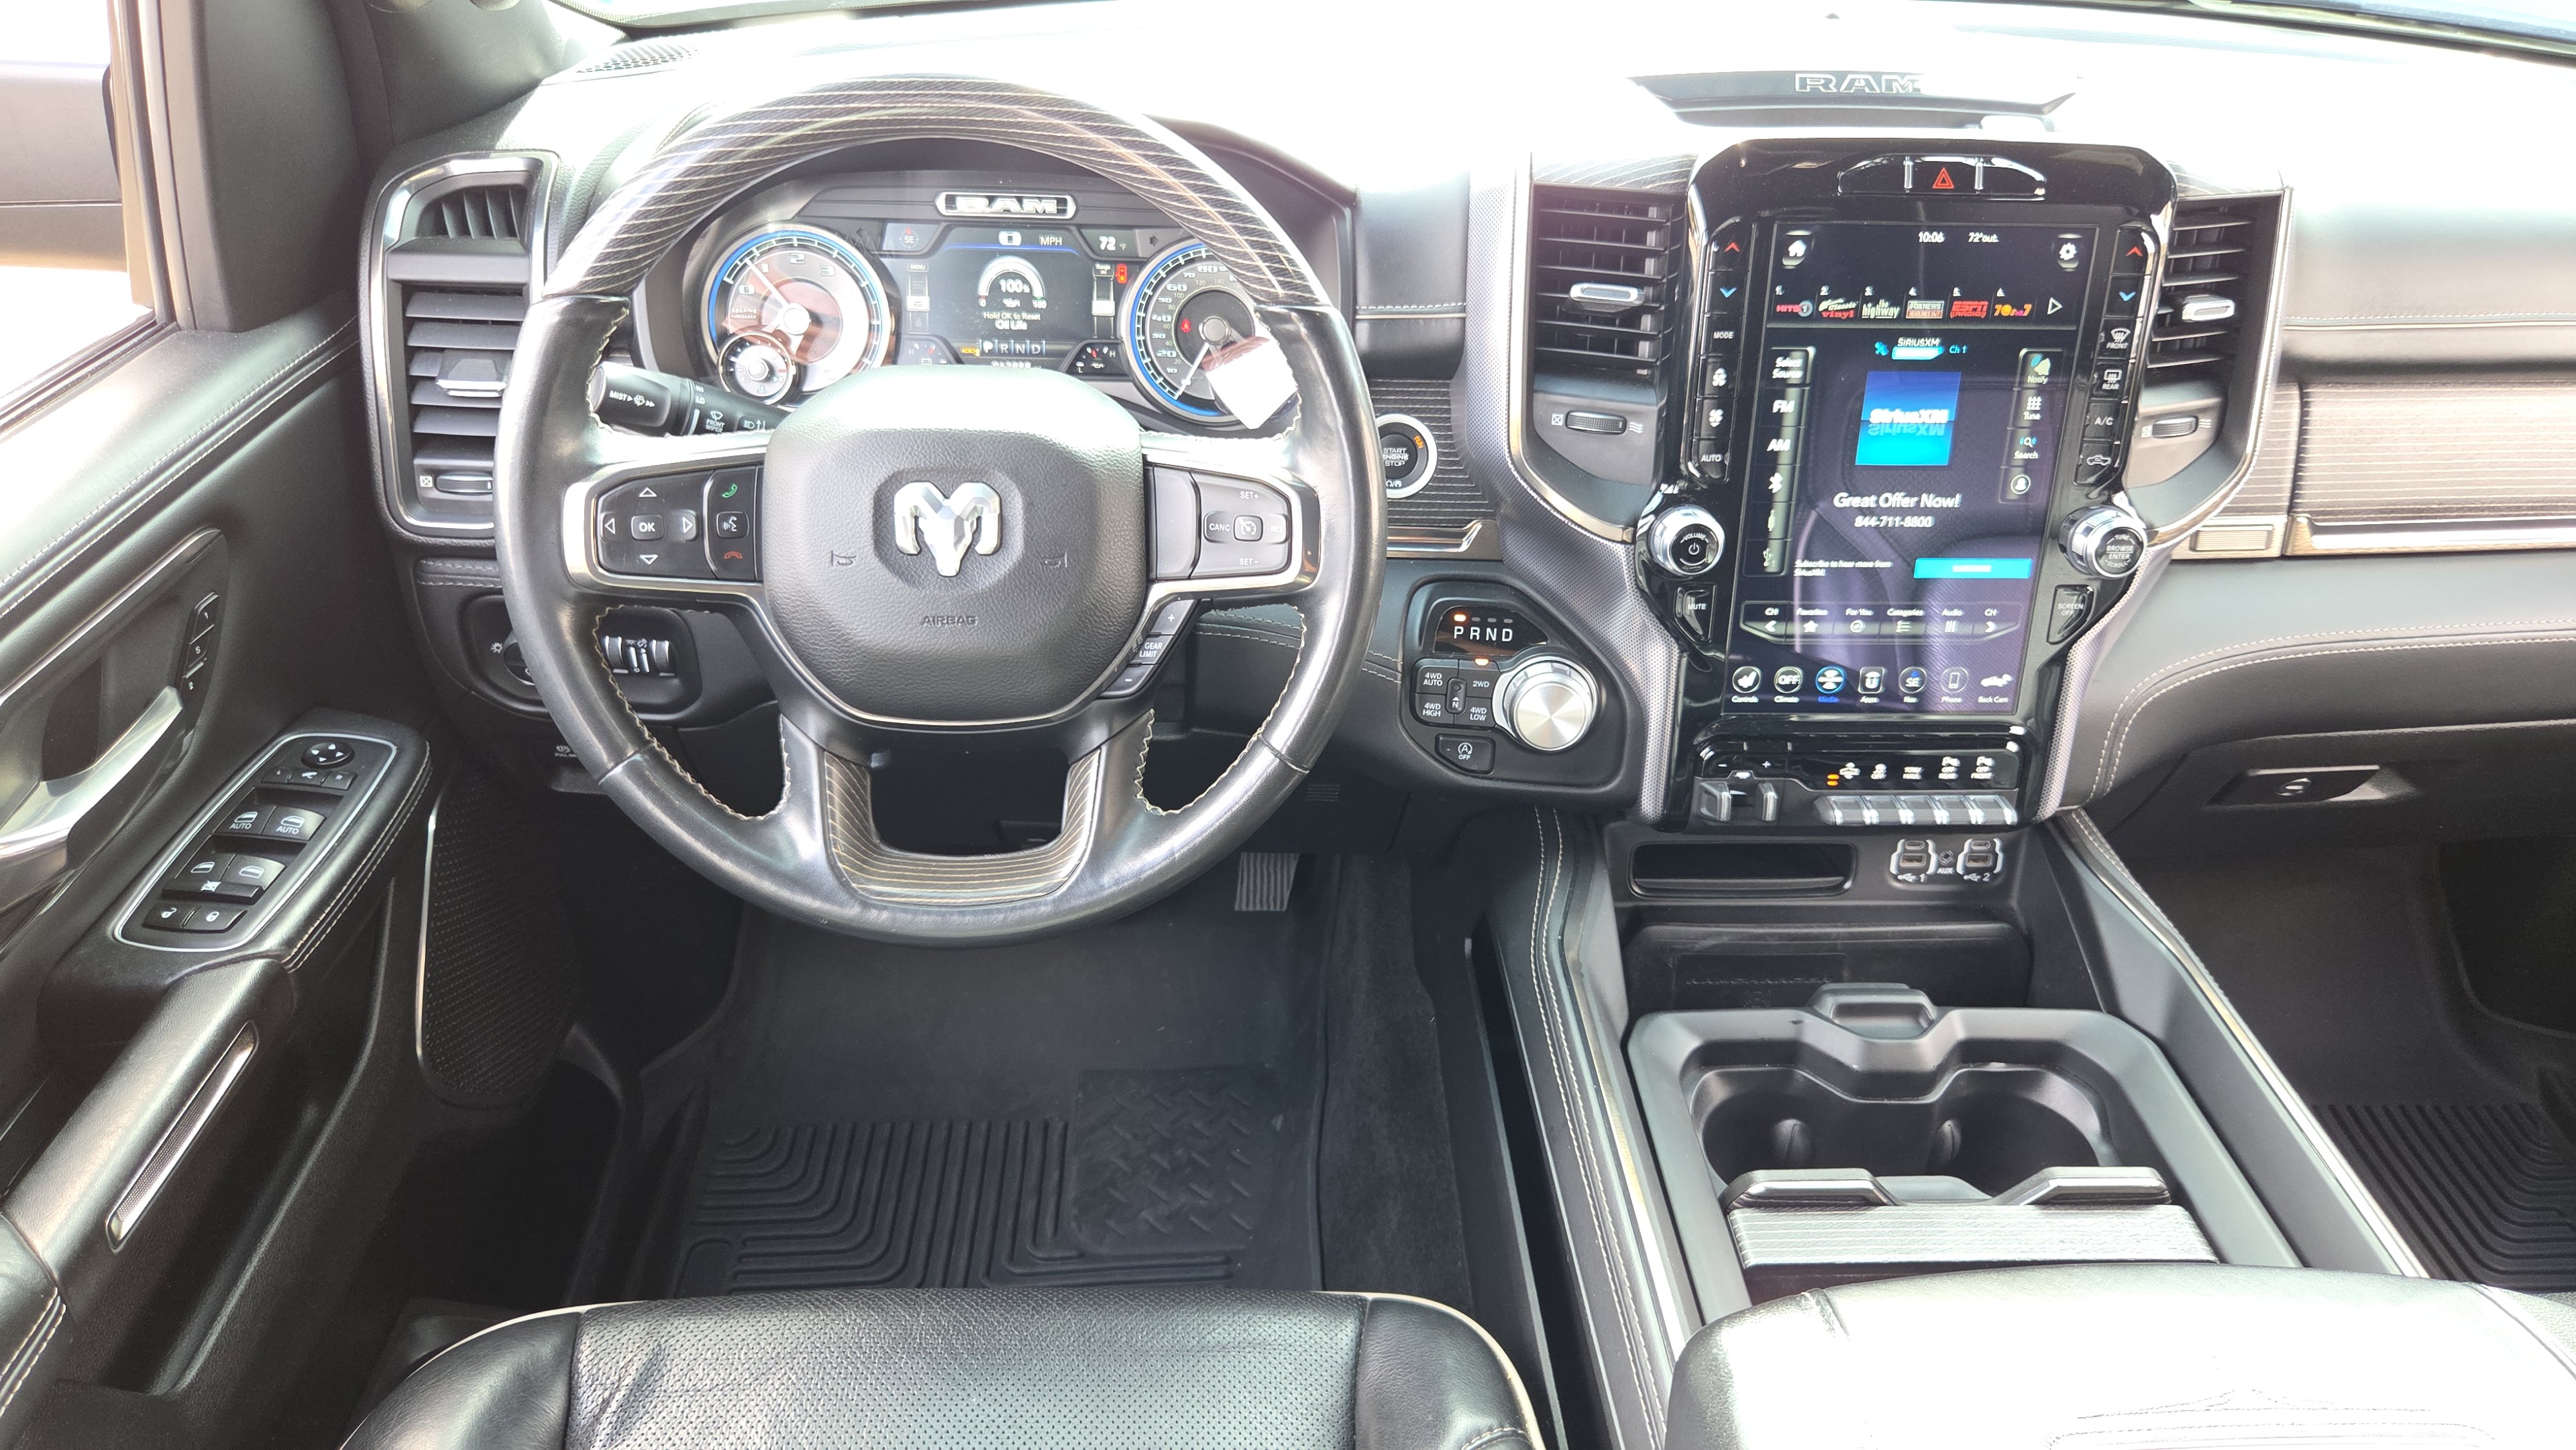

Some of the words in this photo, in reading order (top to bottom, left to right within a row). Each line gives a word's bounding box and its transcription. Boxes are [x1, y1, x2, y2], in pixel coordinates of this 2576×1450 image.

[1795, 73, 1923, 94] RAM
[954, 196, 1057, 214] RAM
[1039, 235, 1063, 246] MPH
[1918, 231, 1946, 243] 10:06
[1099, 236, 1116, 250] 72
[790, 253, 806, 264] 2
[759, 263, 770, 273] 1
[819, 265, 836, 276] 3
[1197, 264, 1218, 273] 80
[739, 284, 755, 295] 0
[1032, 299, 1047, 309] 100
[1952, 301, 1989, 312] ESPN
[1821, 310, 1855, 319] vinyl
[1862, 303, 1901, 319] highway
[983, 312, 1001, 320] Hold
[1022, 312, 1041, 321] Reset
[1713, 331, 1734, 339] MODE
[983, 341, 993, 353] P
[999, 343, 1009, 353] R
[1015, 343, 1025, 354] N
[1031, 344, 1041, 354] D
[1949, 345, 1961, 353] Ch
[1157, 349, 1177, 357] 20
[2027, 375, 2048, 384] Notify
[609, 390, 627, 400] MIST
[1772, 400, 1795, 413] FM
[2023, 411, 2041, 420] Tune
[706, 419, 725, 428] FRONT
[2094, 417, 2114, 426] A/C
[1766, 439, 1791, 451] AM
[1701, 454, 1722, 462] AUTO
[2014, 450, 2038, 459] Search
[1833, 493, 1877, 507] Great
[1879, 493, 1918, 507] Offer
[1920, 493, 1962, 508] Now!
[1854, 516, 1934, 527] 844-711-8800
[639, 522, 656, 532] OK
[1209, 523, 1230, 531] CANC
[1270, 525, 1283, 533] RES
[1682, 532, 1707, 541] VOLUME
[1765, 607, 1779, 616] CH
[1984, 608, 1997, 616] CH
[922, 615, 978, 626] AIRBAG
[1454, 626, 1464, 639] P
[1470, 626, 1481, 641] R
[1486, 627, 1497, 641] N
[1501, 628, 1513, 643] D
[1777, 675, 1801, 686] OFF
[1905, 677, 1922, 687] SE
[1859, 695, 1880, 704] Apps
[276, 826, 299, 835] AUTO
